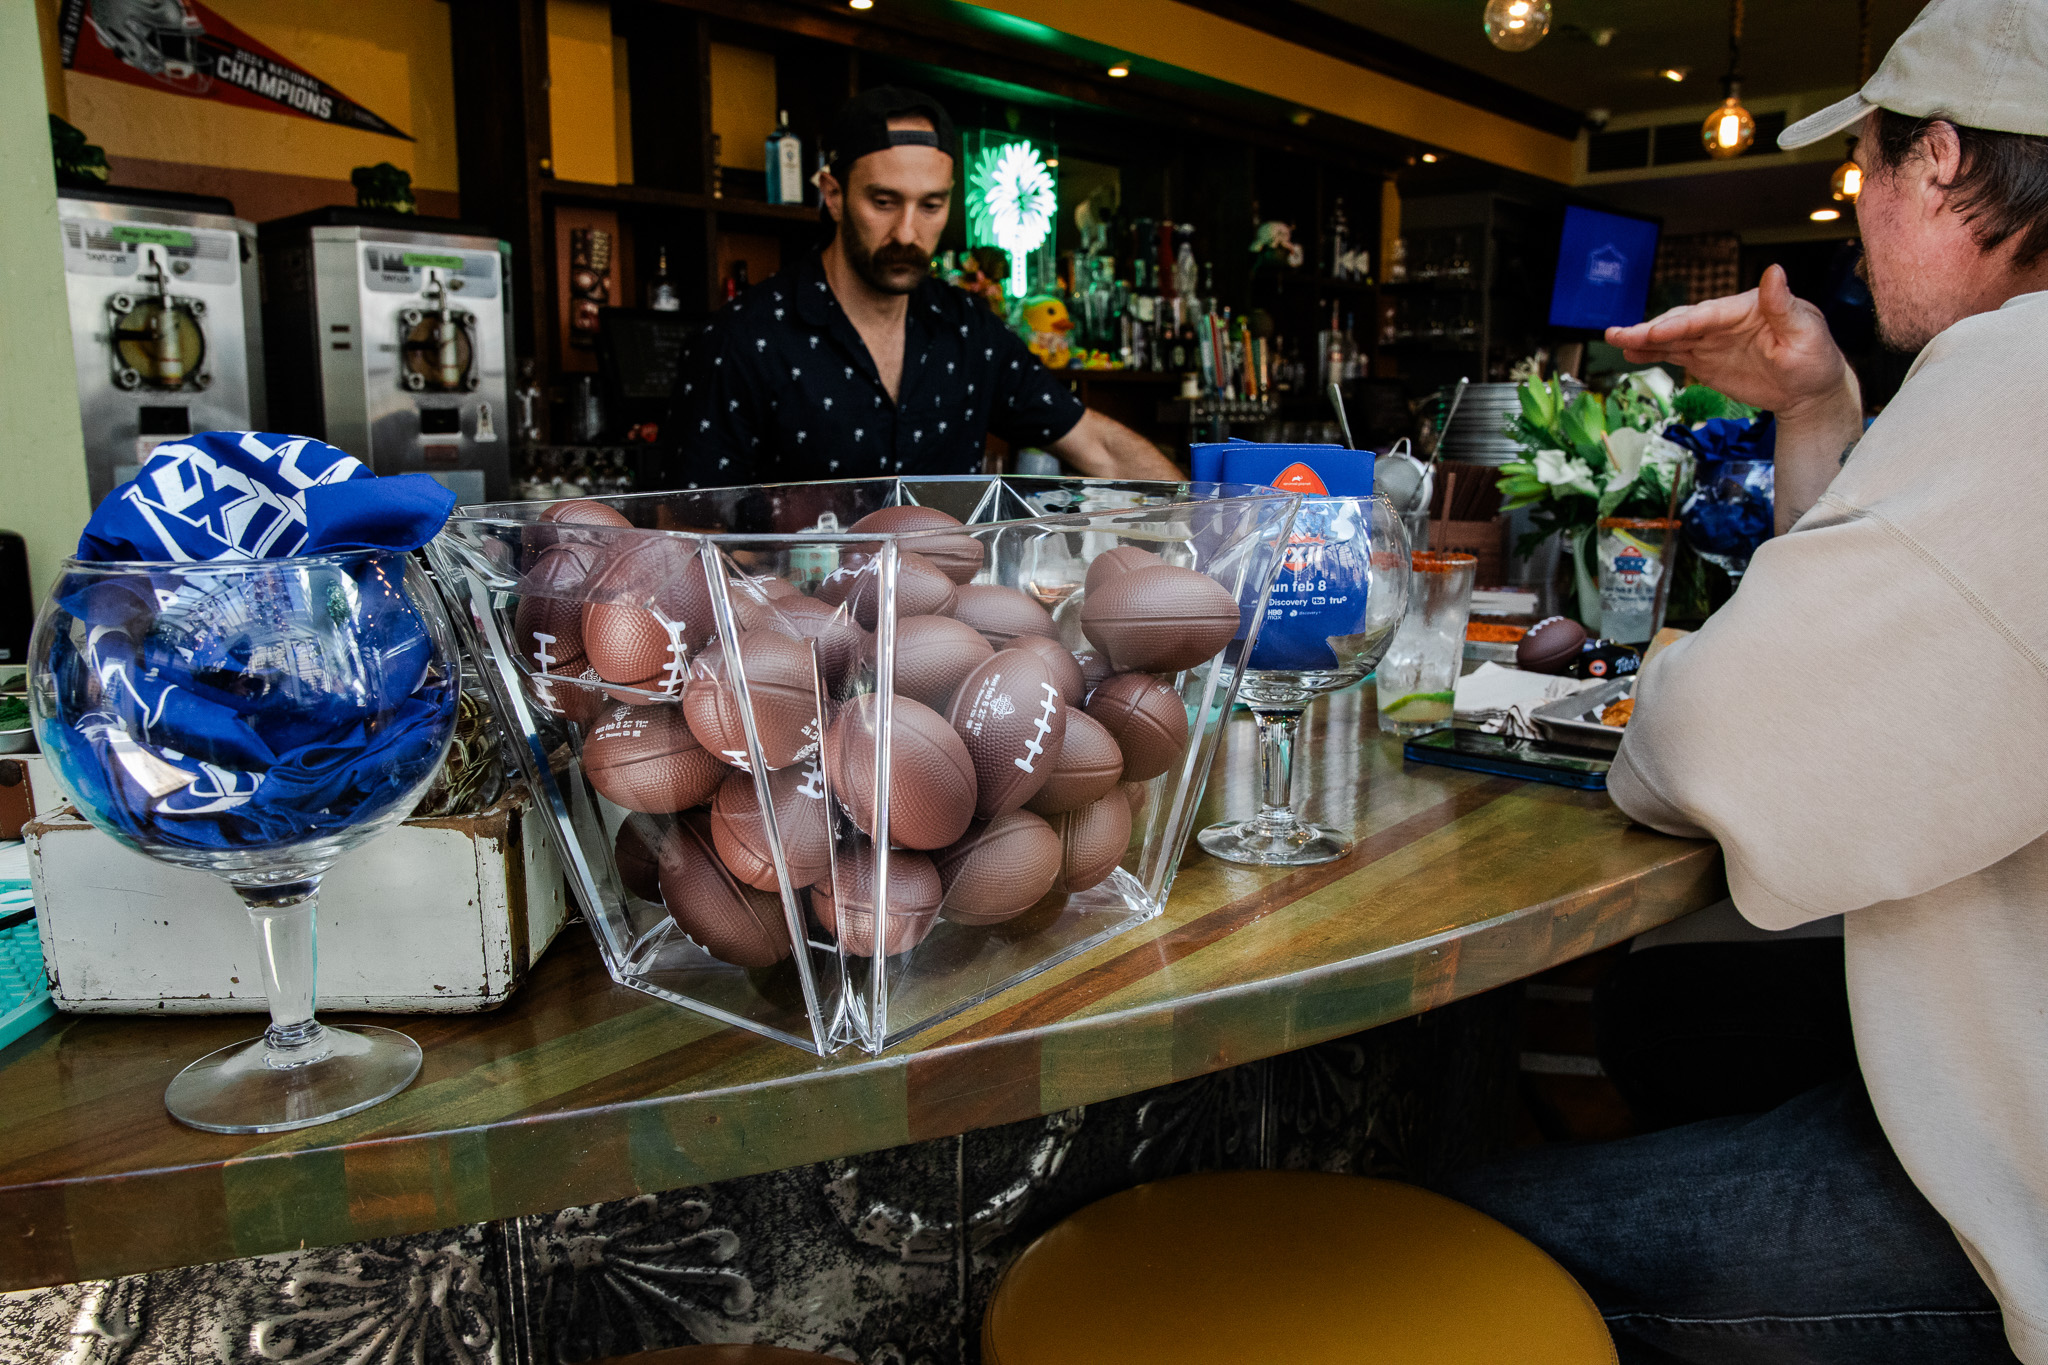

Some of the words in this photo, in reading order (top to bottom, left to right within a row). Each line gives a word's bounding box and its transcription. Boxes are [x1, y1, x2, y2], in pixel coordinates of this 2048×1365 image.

[268, 61, 320, 91] NATIONAL
[216, 55, 334, 120] CHAMPIONS
[86, 252, 127, 265] TAYLOR
[1272, 583, 1289, 593] un
[1292, 580, 1314, 593] feb
[1317, 579, 1327, 592] 8
[1269, 598, 1308, 607] Discovery
